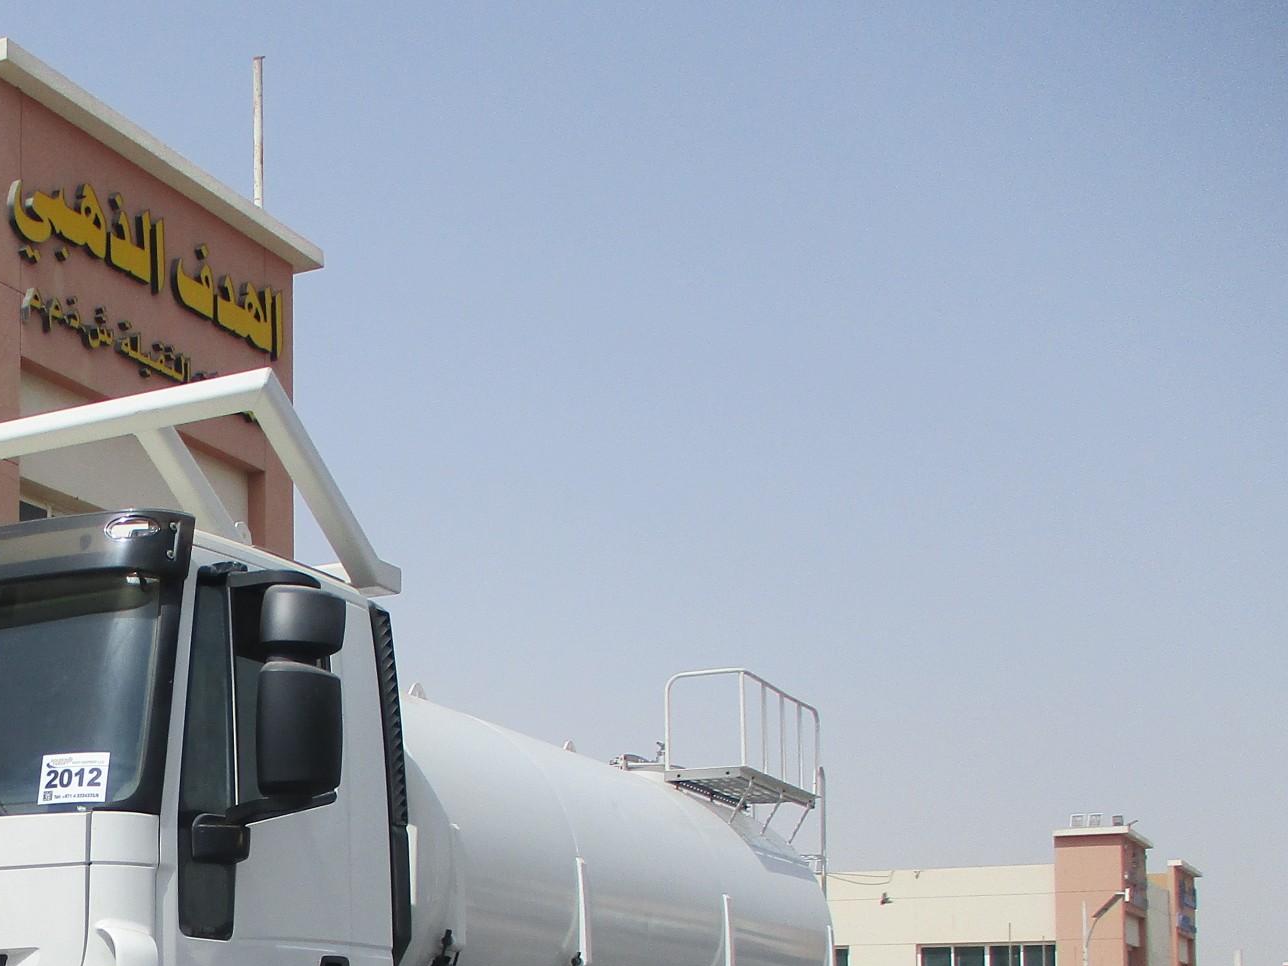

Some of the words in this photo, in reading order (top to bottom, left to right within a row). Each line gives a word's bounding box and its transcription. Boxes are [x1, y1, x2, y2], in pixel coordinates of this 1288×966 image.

[6, 179, 165, 295] الذهبي
[170, 243, 284, 362] الهدف
[44, 767, 103, 789] 2012
